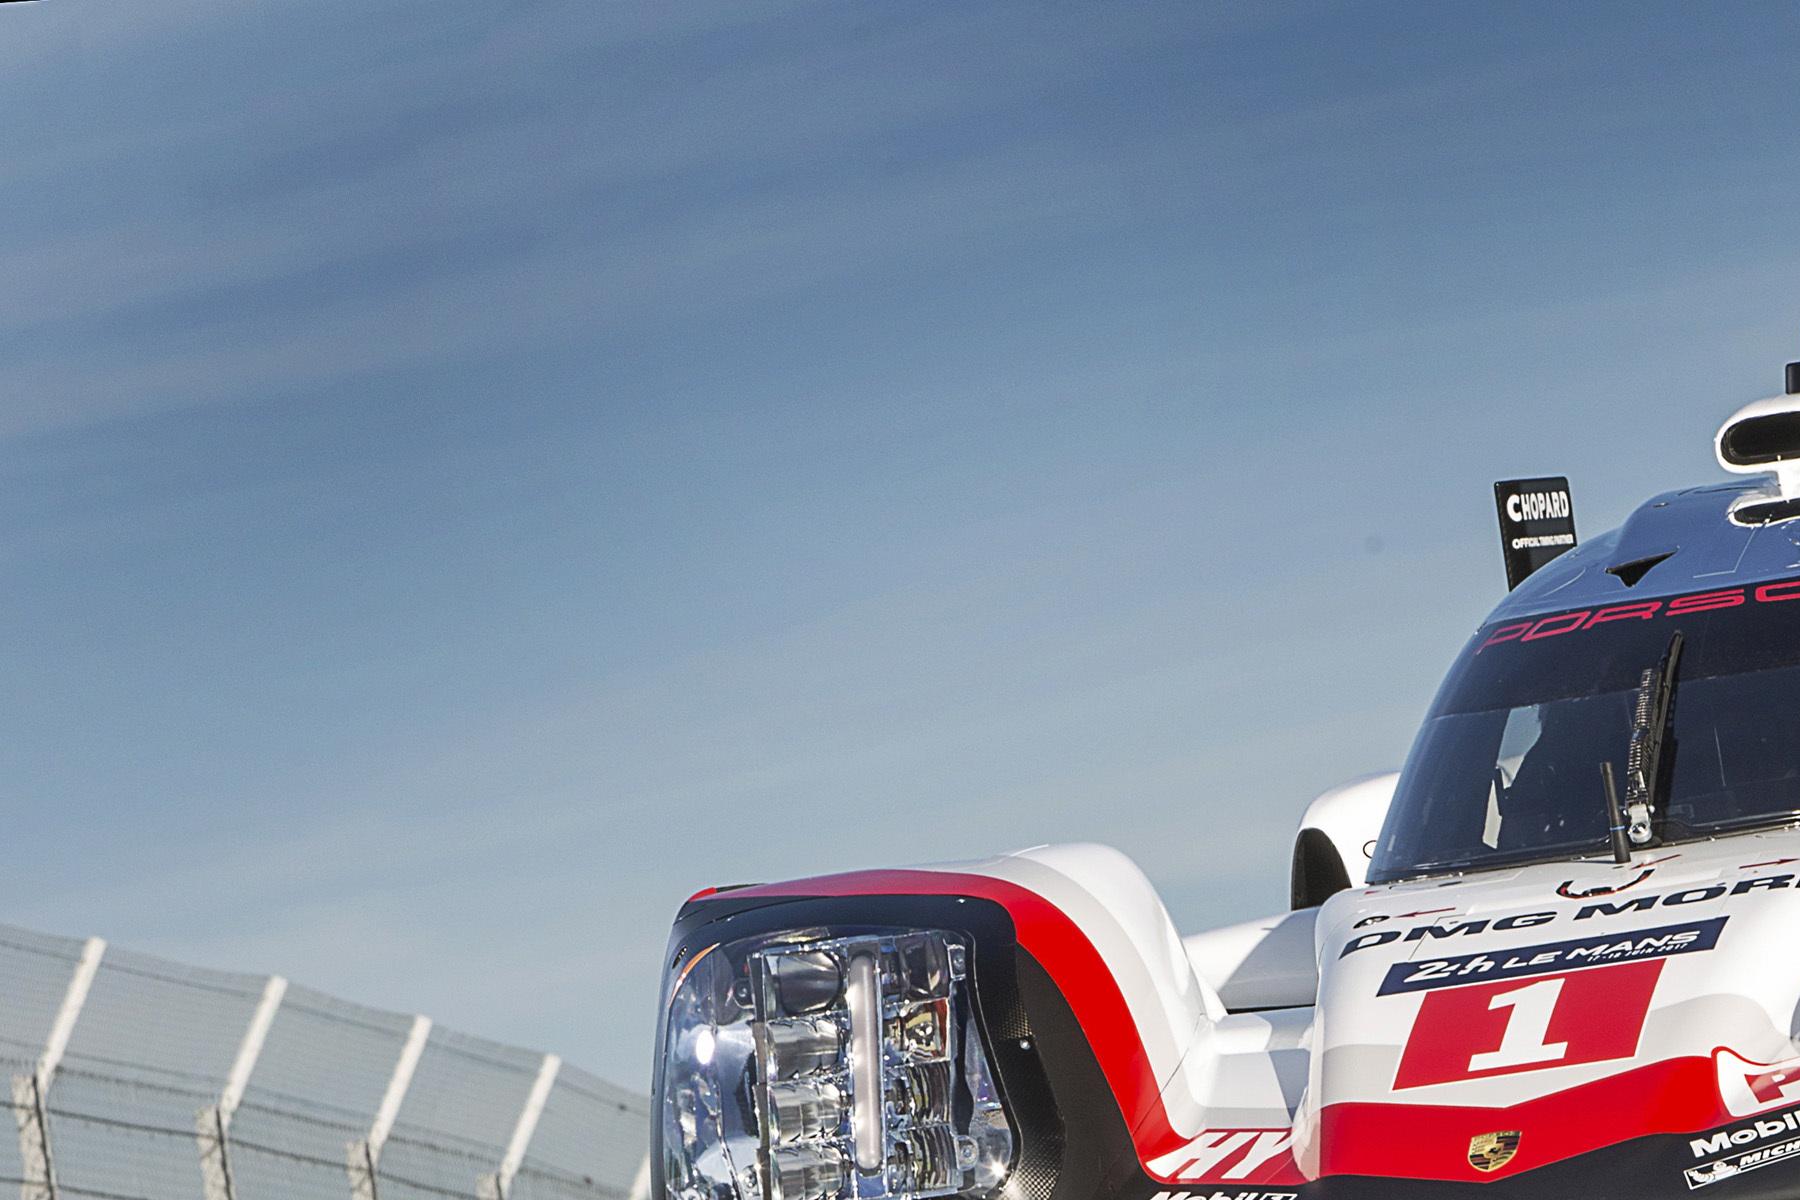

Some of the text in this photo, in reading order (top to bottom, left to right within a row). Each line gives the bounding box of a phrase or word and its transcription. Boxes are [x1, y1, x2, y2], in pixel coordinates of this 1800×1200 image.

[1506, 491, 1570, 522] CHOPARD
[1339, 909, 1557, 960] DMG
[1502, 950, 1562, 970] LE
[1566, 930, 1701, 961] MANS
[1468, 979, 1568, 1072] 1
[1146, 1131, 1294, 1180] HY
